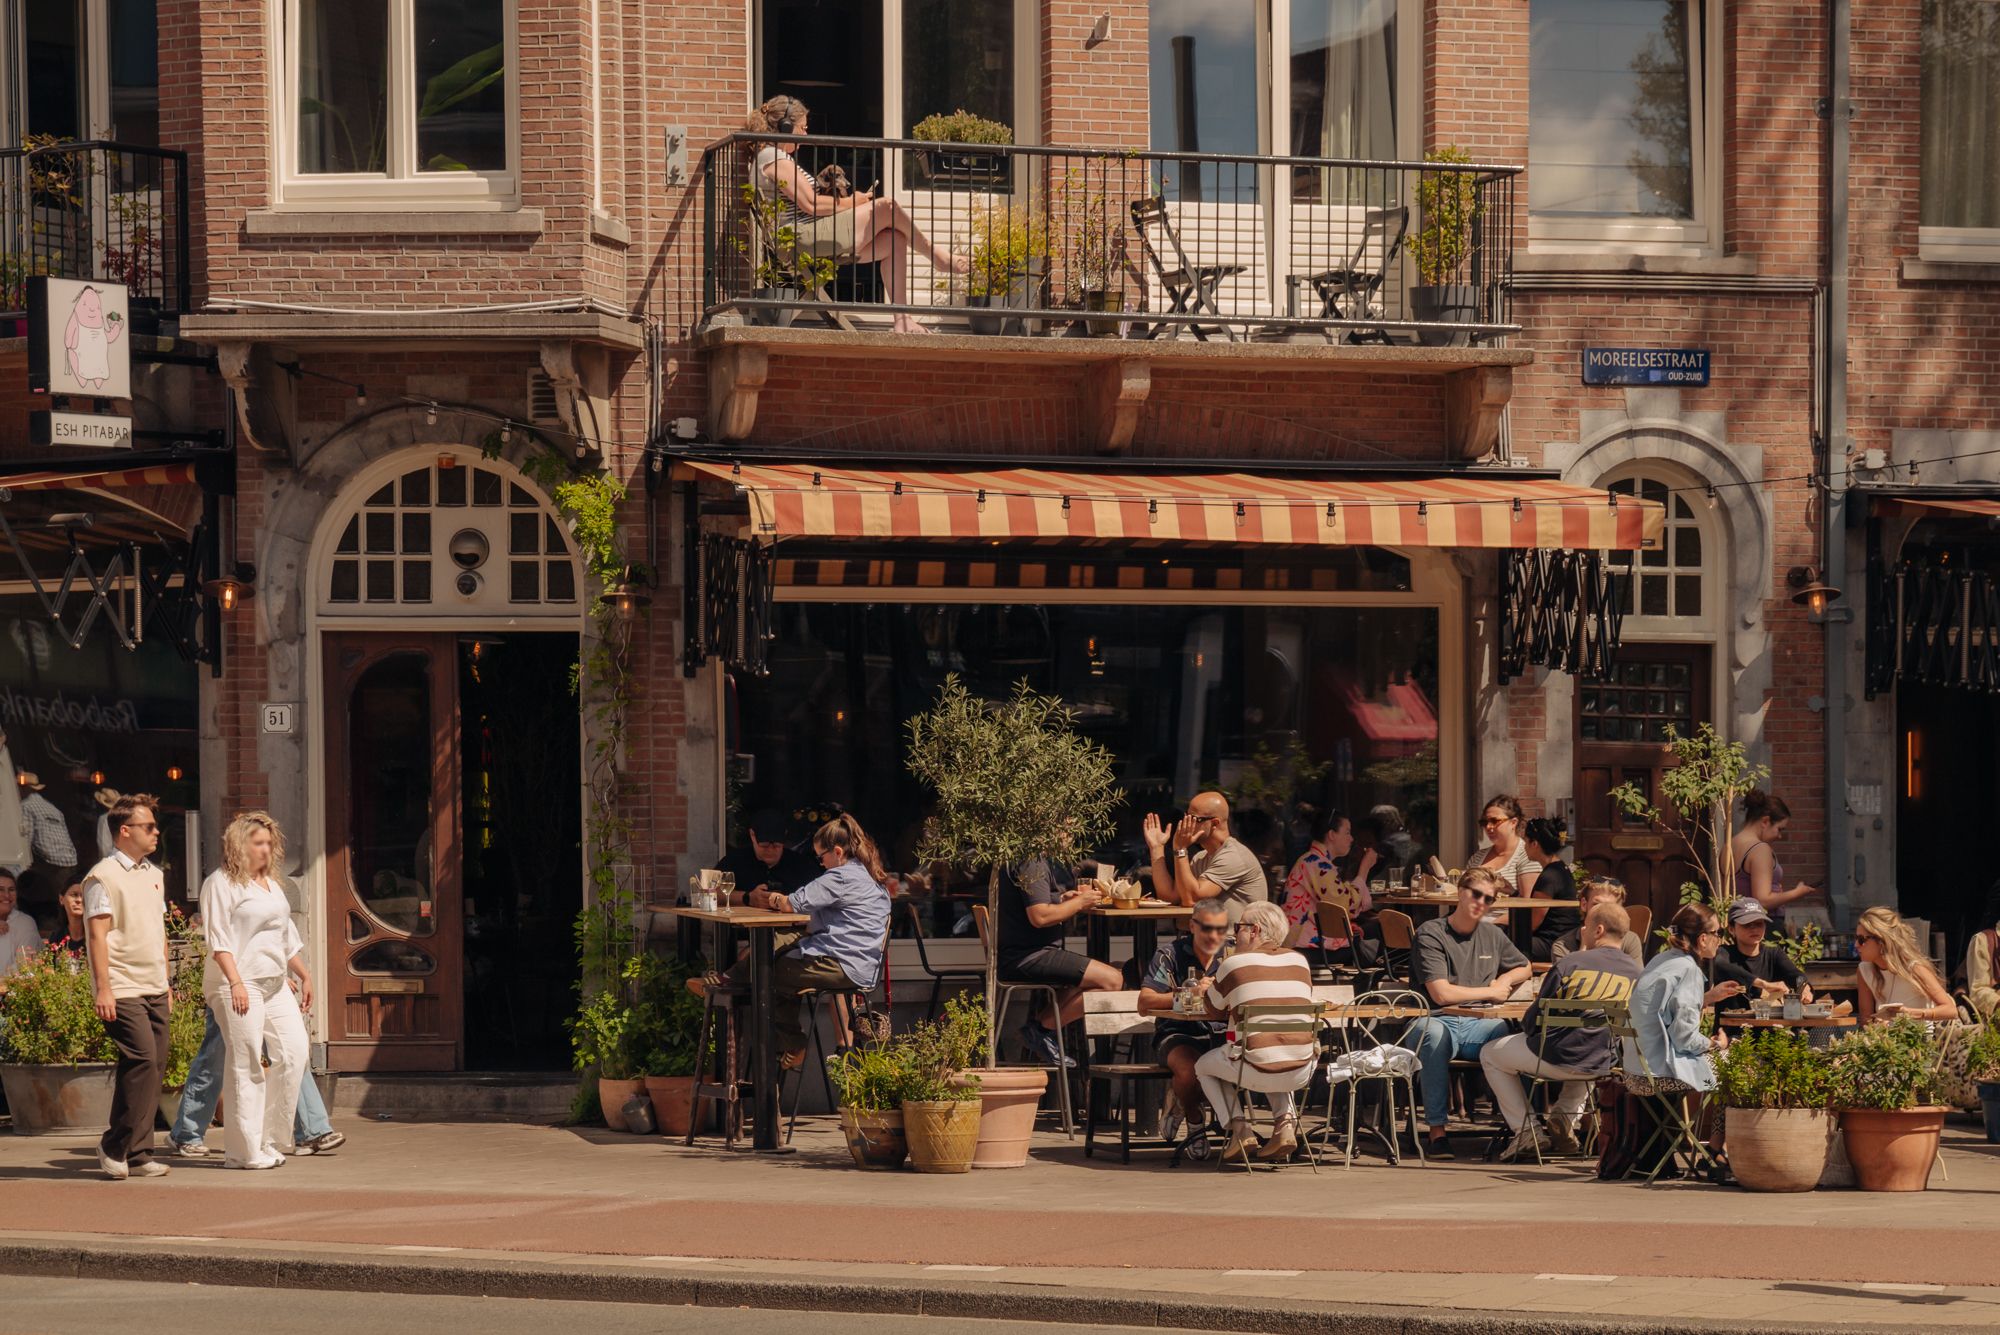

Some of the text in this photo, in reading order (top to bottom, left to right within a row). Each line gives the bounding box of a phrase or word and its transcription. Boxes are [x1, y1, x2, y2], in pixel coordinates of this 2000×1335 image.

[1589, 351, 1704, 368] MOREELSESTRAAT
[1668, 371, 1702, 381] OUD-ZUID
[55, 422, 129, 440] ESH PITABAR
[269, 711, 284, 726] 51
